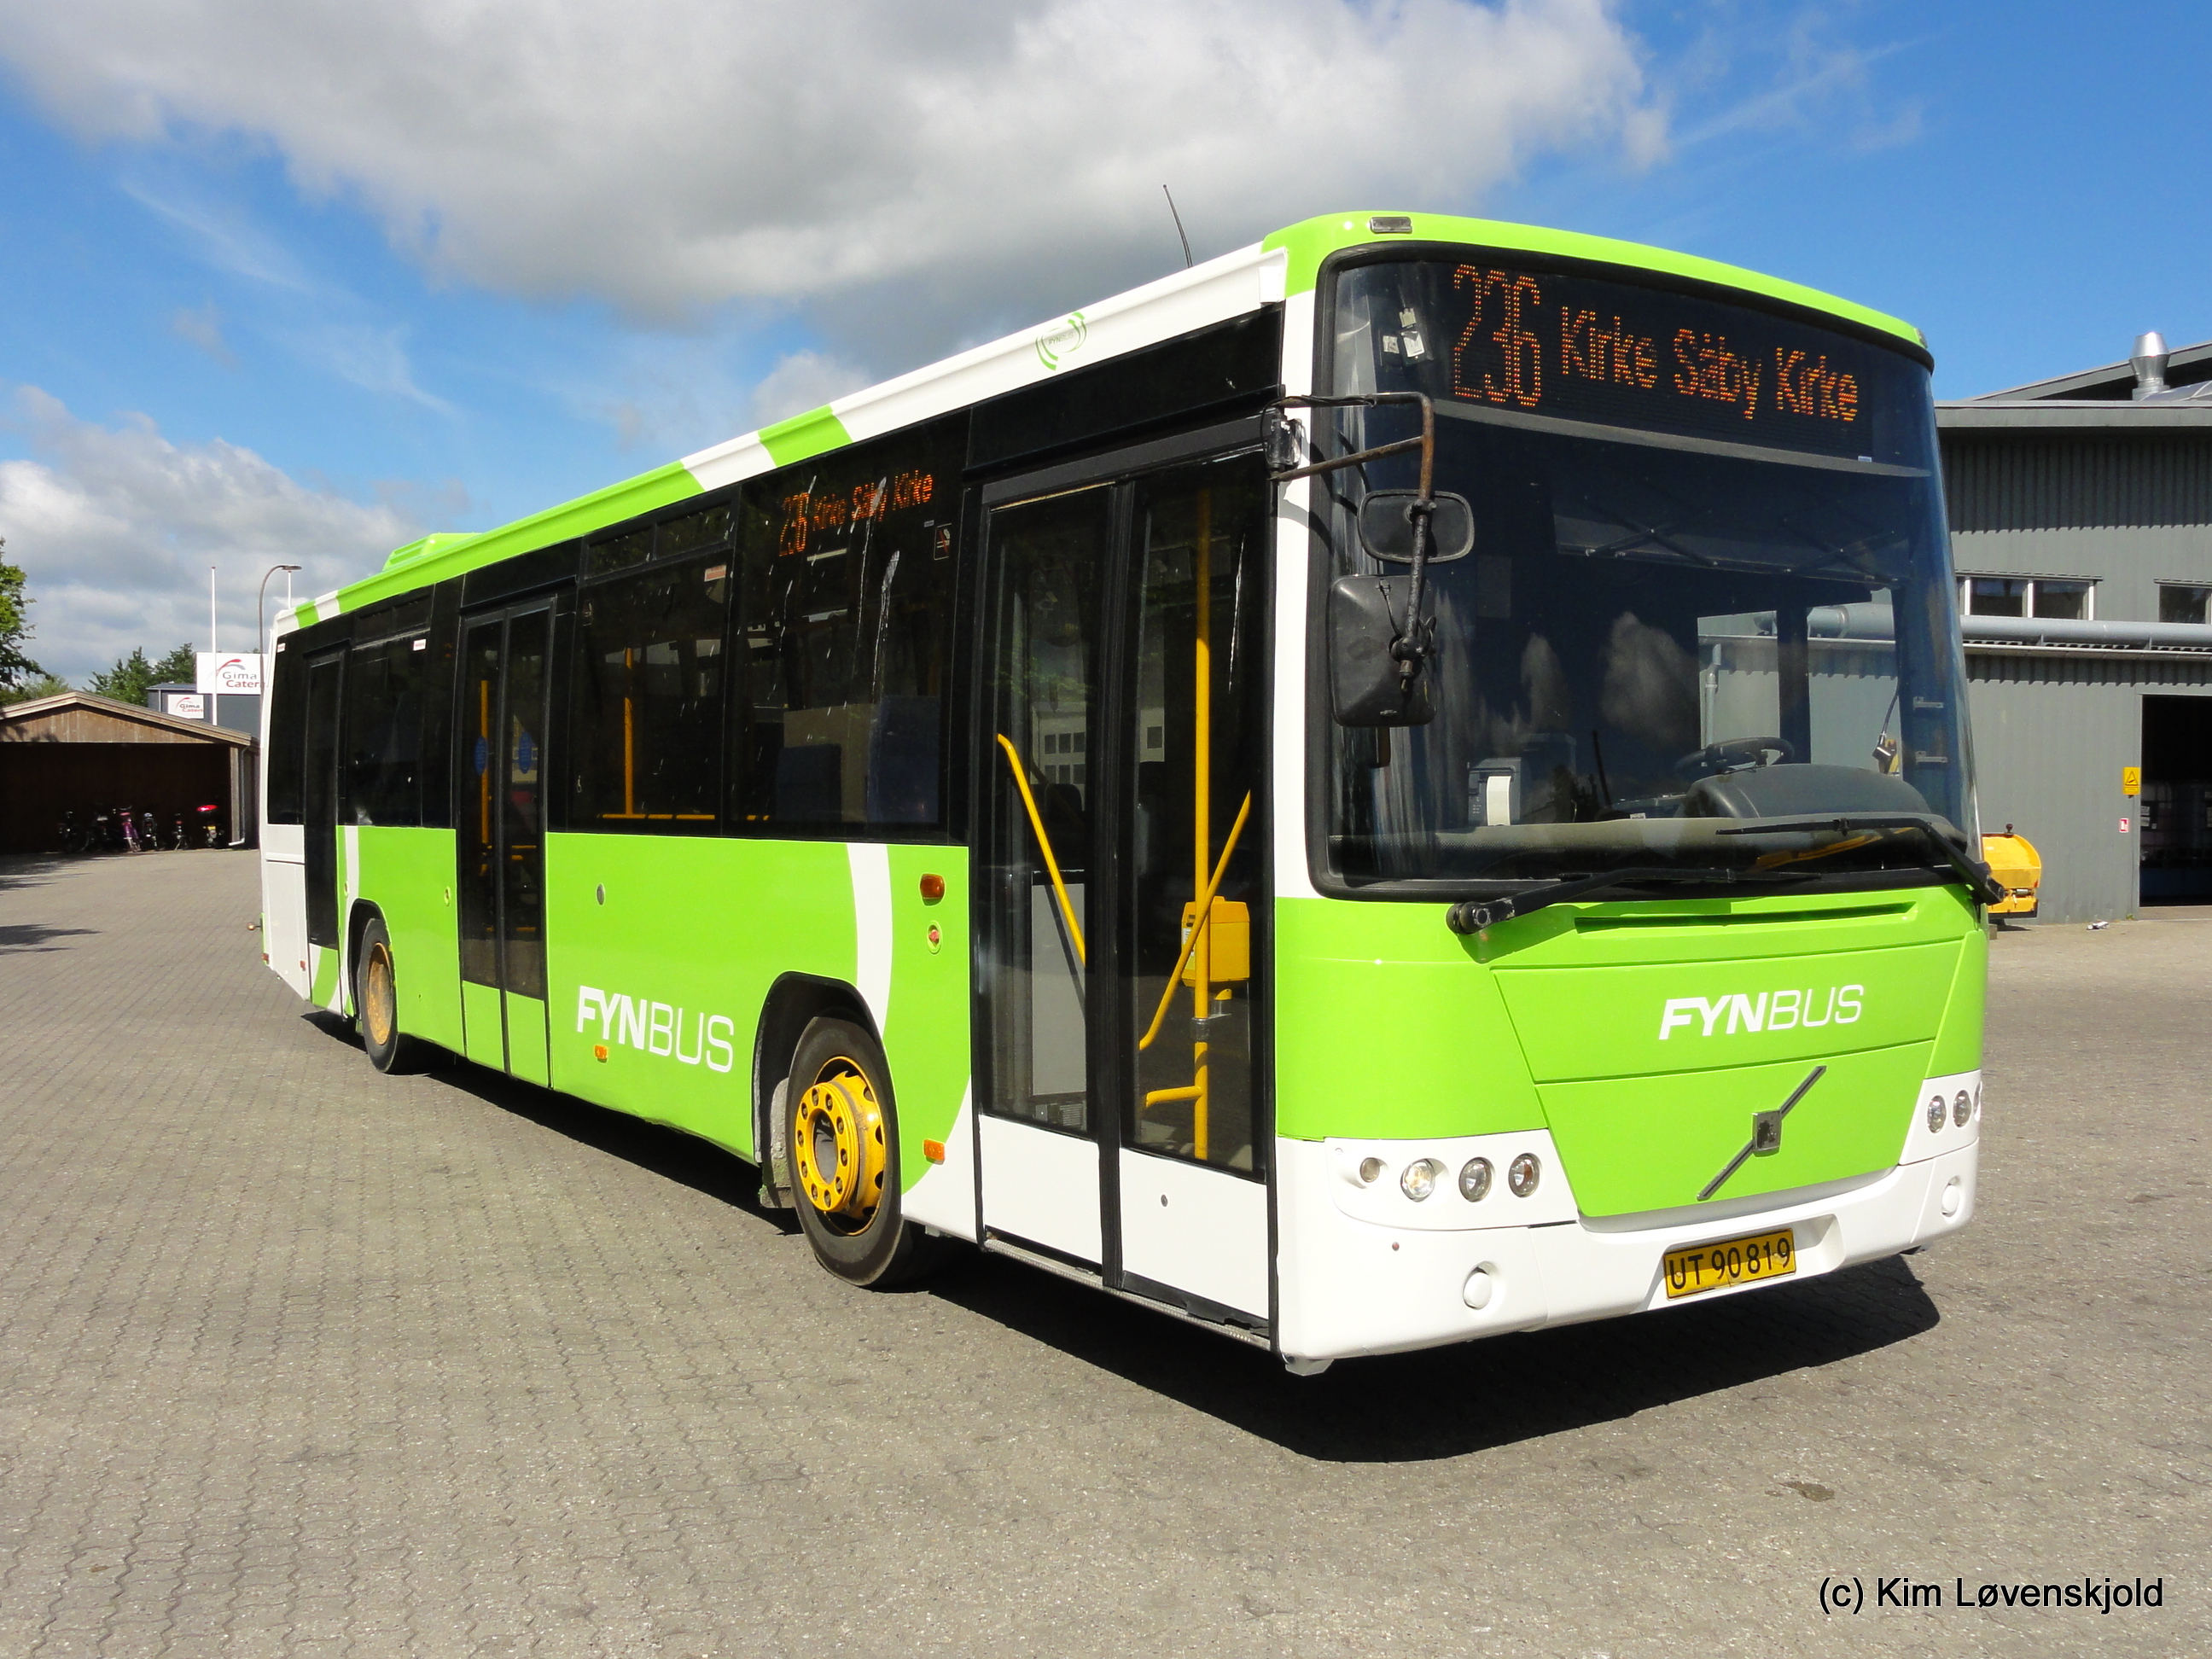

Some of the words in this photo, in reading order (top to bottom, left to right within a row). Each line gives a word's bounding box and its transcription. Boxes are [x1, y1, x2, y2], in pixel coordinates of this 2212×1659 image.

[1452, 264, 1542, 407] 236
[1561, 305, 1658, 389] Kirke
[1674, 328, 1762, 420] Säby
[1775, 346, 1859, 422] Kirke
[893, 469, 933, 510] Kirke
[577, 985, 734, 1074] FYNBUS
[1658, 984, 1864, 1040] FYNBUS
[1668, 1253, 1703, 1290] UT
